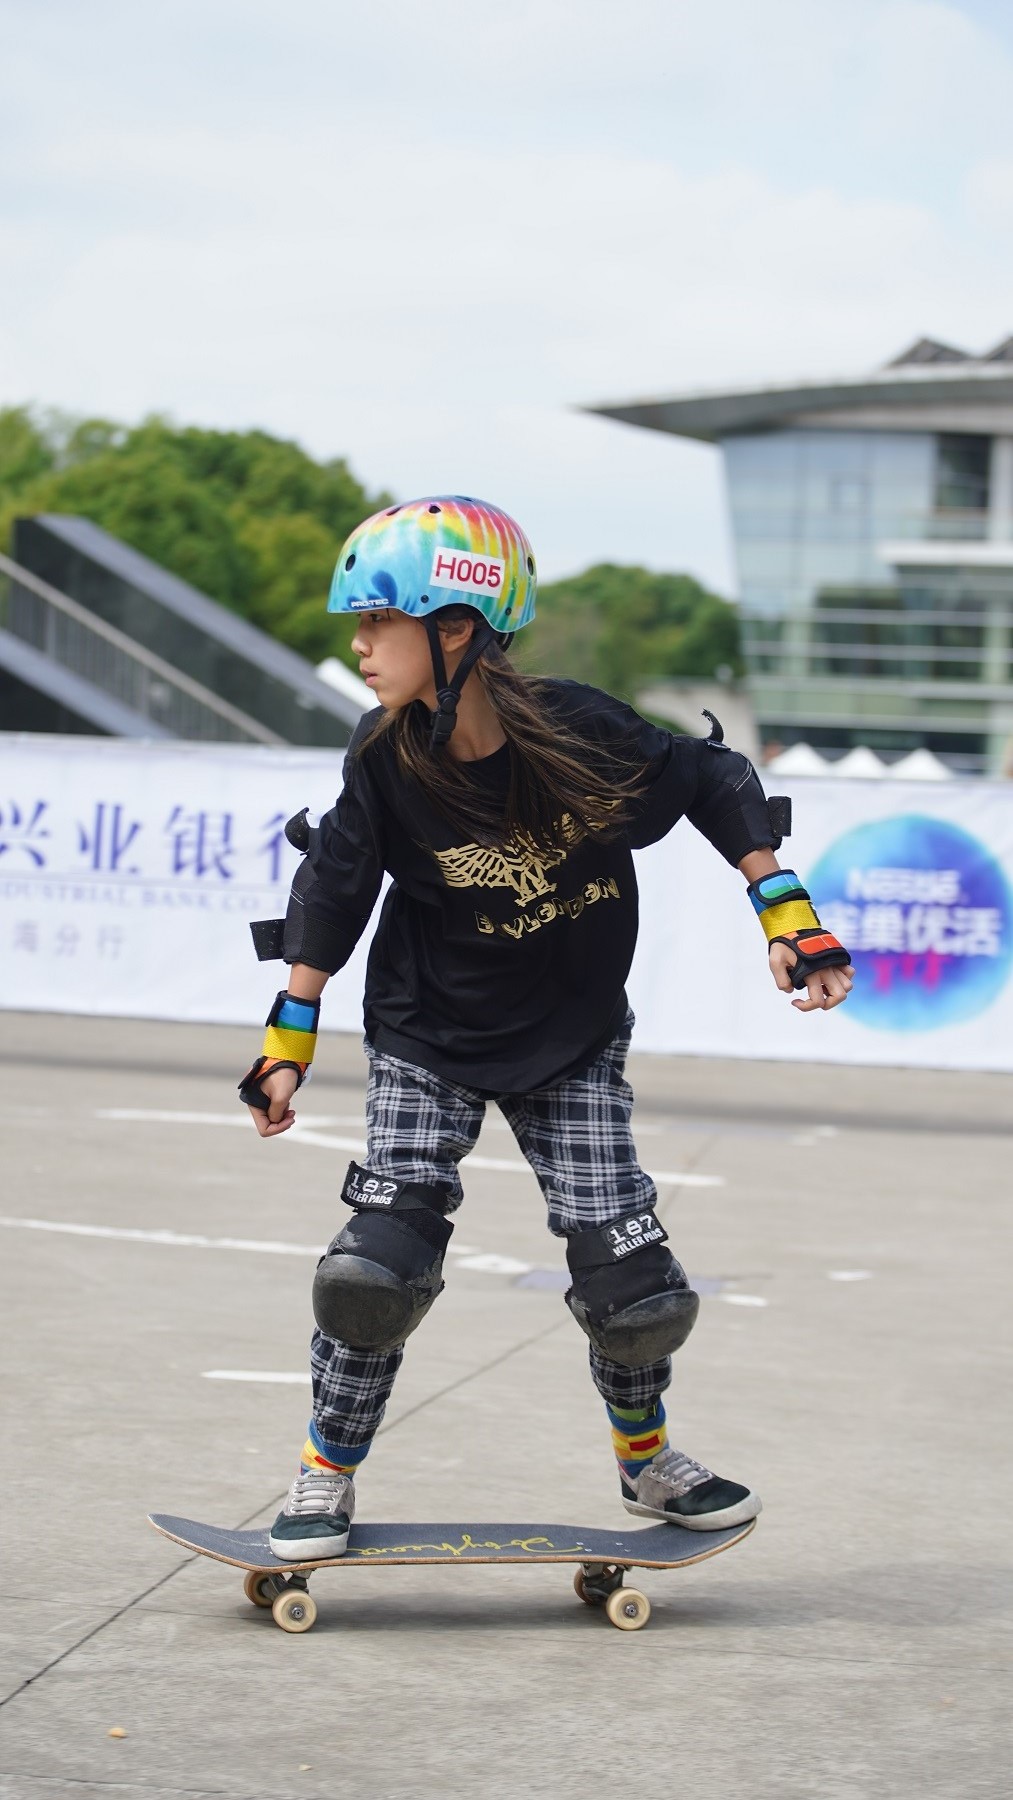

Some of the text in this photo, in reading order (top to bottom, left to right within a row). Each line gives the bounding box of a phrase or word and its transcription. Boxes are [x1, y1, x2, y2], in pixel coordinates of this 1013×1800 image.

[434, 554, 502, 588] H005
[350, 598, 389, 608] PRO-TEC
[474, 910, 523, 940] BY
[350, 1172, 398, 1194] 187
[367, 1194, 393, 1205] PADS
[609, 1213, 653, 1244] 187
[612, 1227, 664, 1257] KILLER PADS
